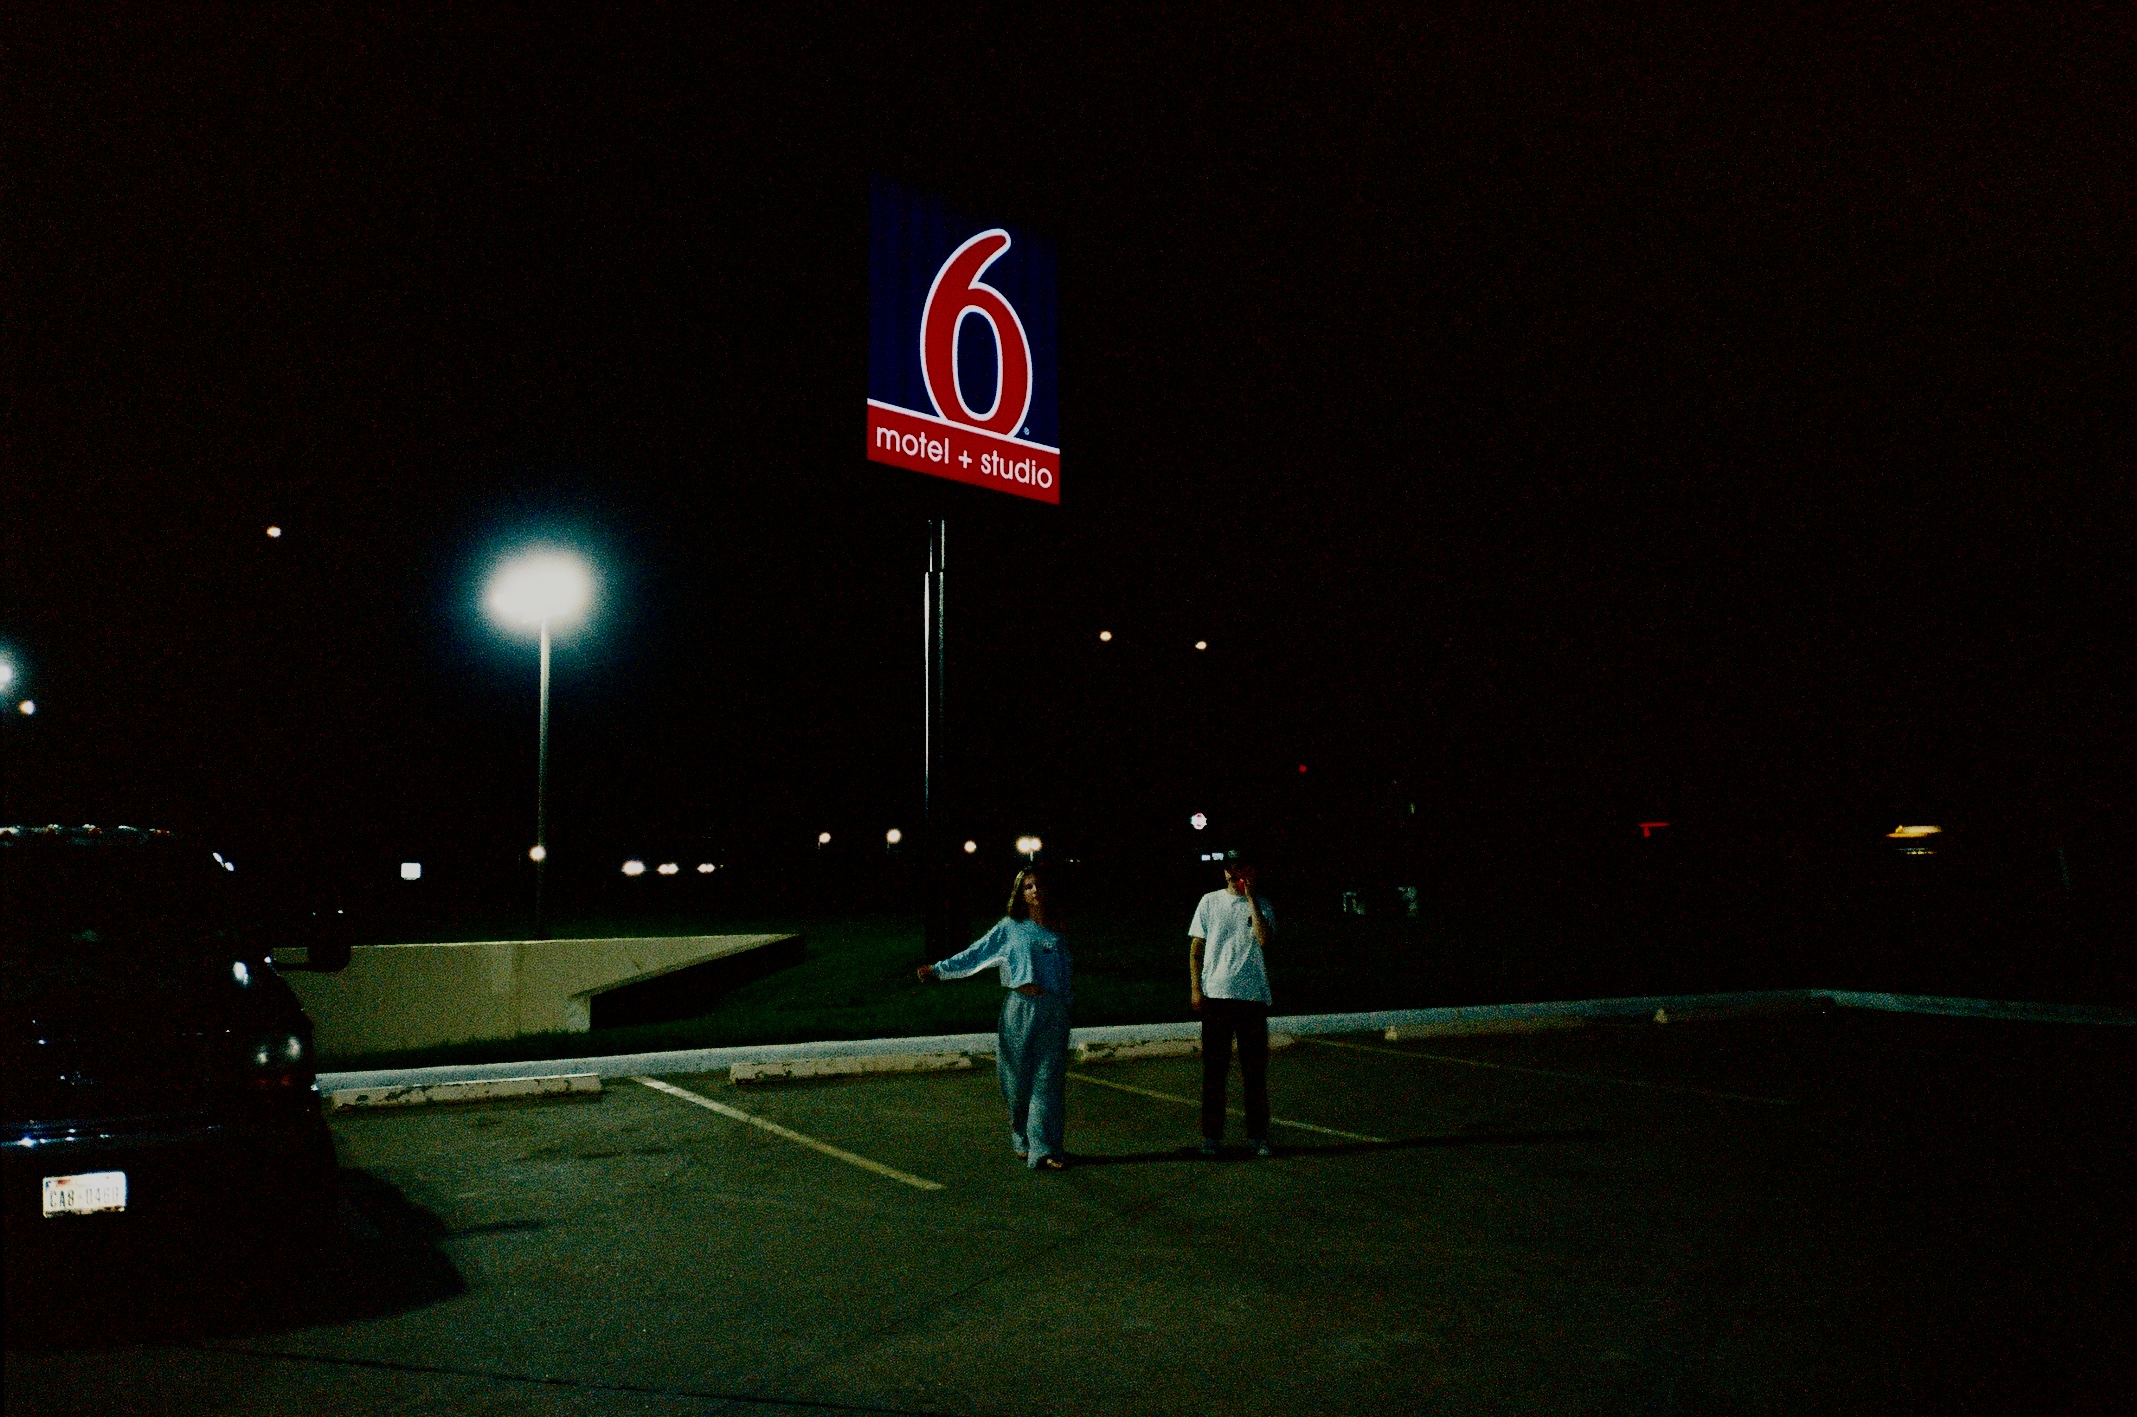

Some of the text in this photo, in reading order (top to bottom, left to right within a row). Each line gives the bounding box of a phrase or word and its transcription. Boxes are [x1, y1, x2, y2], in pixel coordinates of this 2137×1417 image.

[919, 228, 1033, 438] 6
[876, 426, 949, 464] motel
[980, 449, 1053, 489] studio
